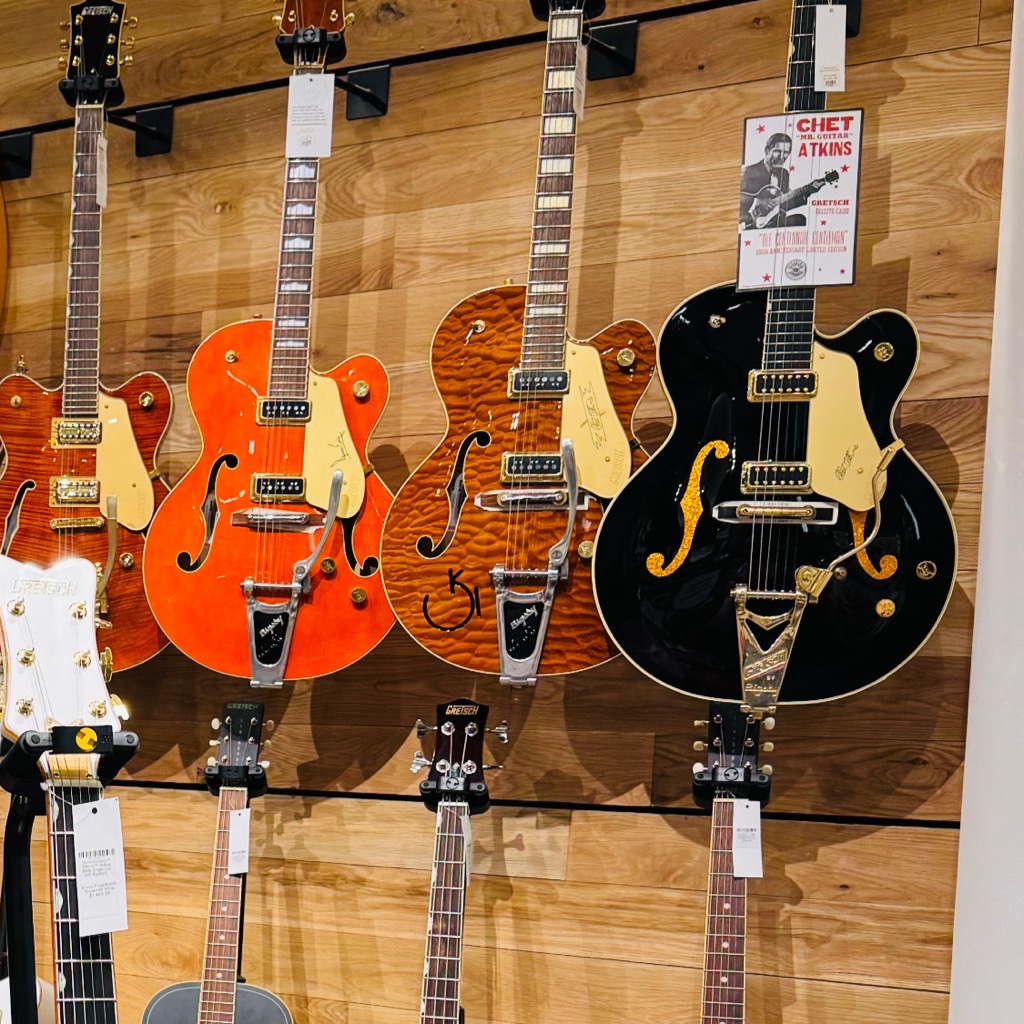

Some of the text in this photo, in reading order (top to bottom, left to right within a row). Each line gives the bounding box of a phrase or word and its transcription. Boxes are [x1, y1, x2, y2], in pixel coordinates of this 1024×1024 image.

[81, 5, 113, 16] GRETSCH
[796, 116, 854, 133] CHET
[798, 141, 852, 157] ATKINS
[12, 578, 79, 596] GRETSCH
[445, 705, 479, 715] GRETSCH
